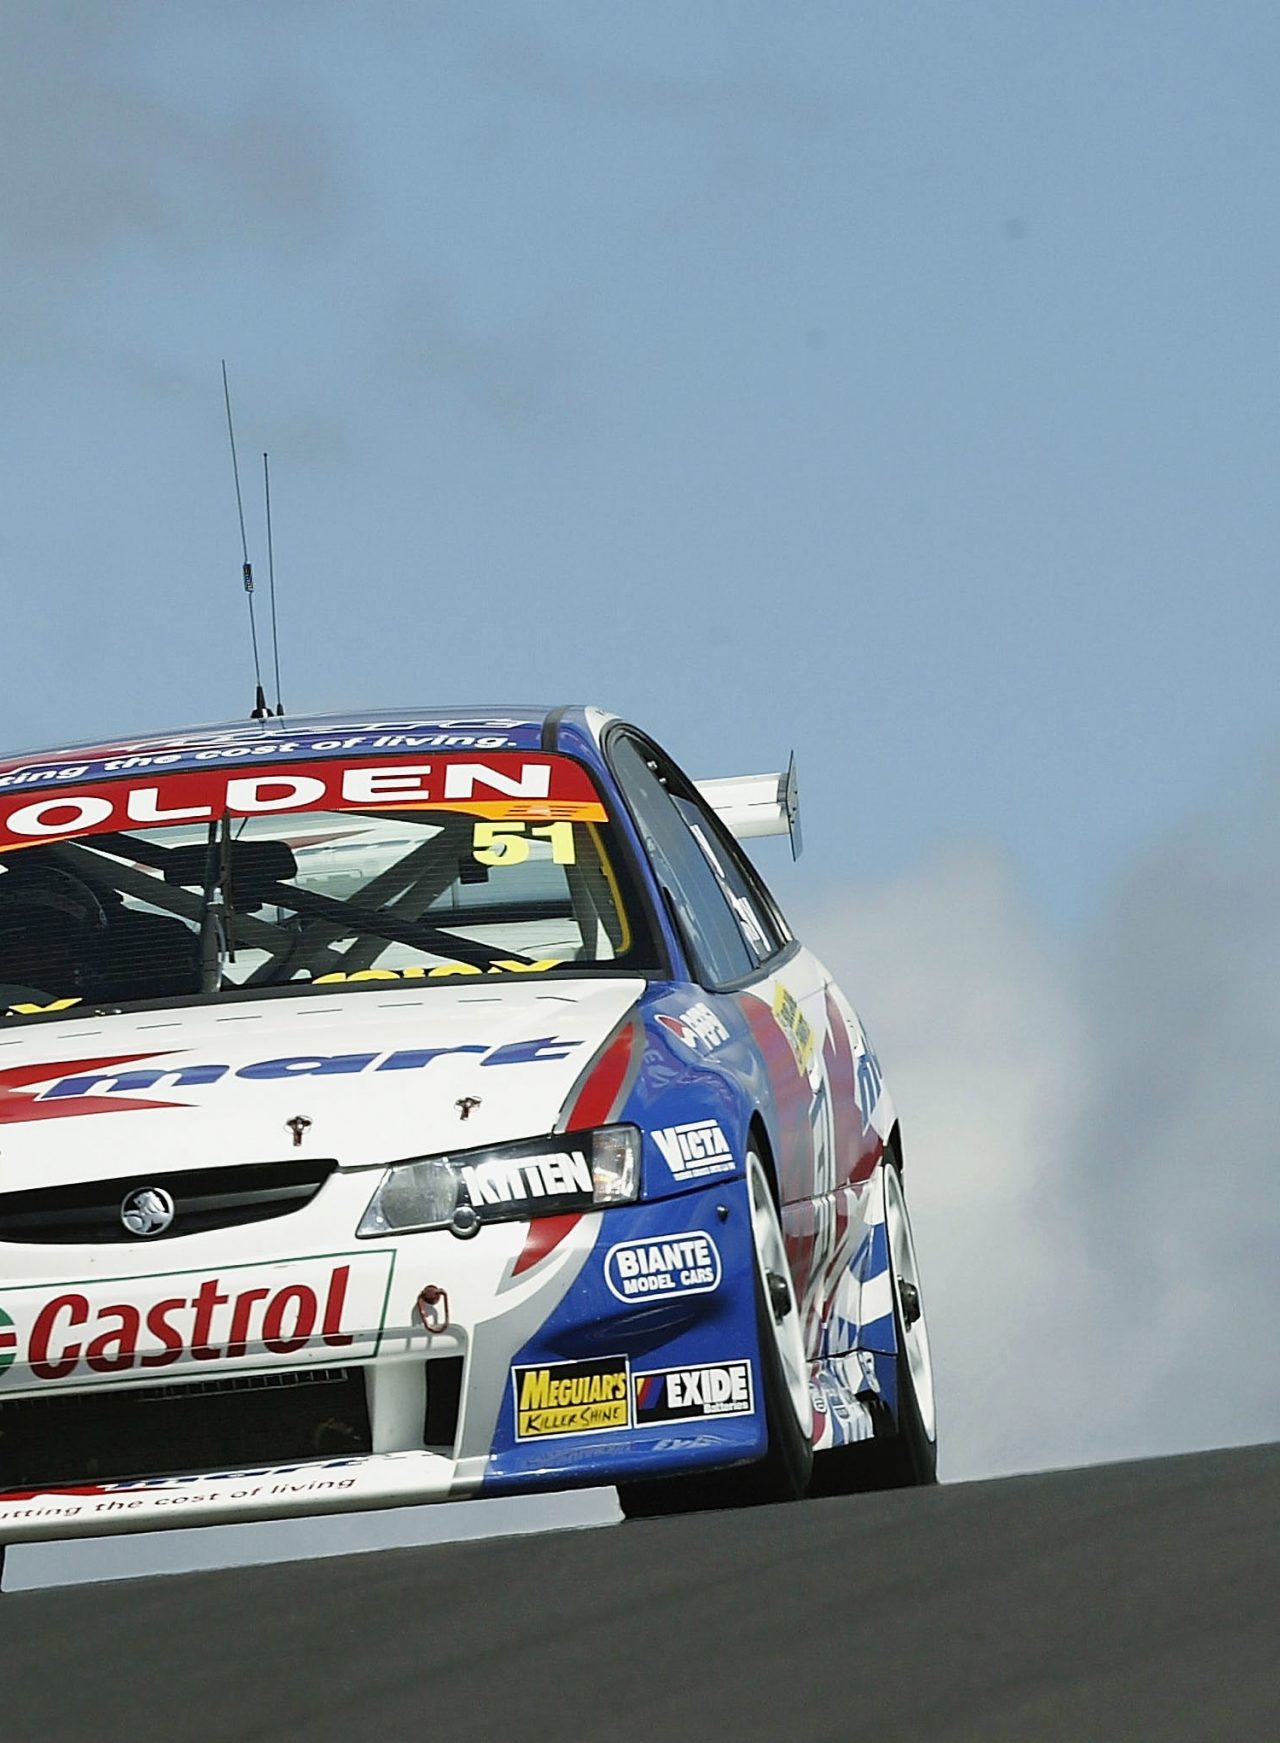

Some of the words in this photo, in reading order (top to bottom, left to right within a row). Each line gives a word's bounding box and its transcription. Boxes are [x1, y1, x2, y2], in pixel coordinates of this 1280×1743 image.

[104, 754, 182, 771] the
[195, 742, 300, 760] cost
[311, 736, 367, 750] of
[472, 821, 576, 867] 51
[461, 1151, 594, 1206] KITTEN
[616, 1239, 712, 1278] BIANTE
[623, 1273, 676, 1295] MODEL
[680, 1267, 714, 1286] CARS
[28, 1265, 354, 1380] Castrol
[666, 1366, 748, 1408] EXIDE
[95, 1501, 144, 1512] the
[155, 1492, 221, 1506] cost
[231, 1486, 264, 1499] of
[271, 1478, 358, 1495] living
